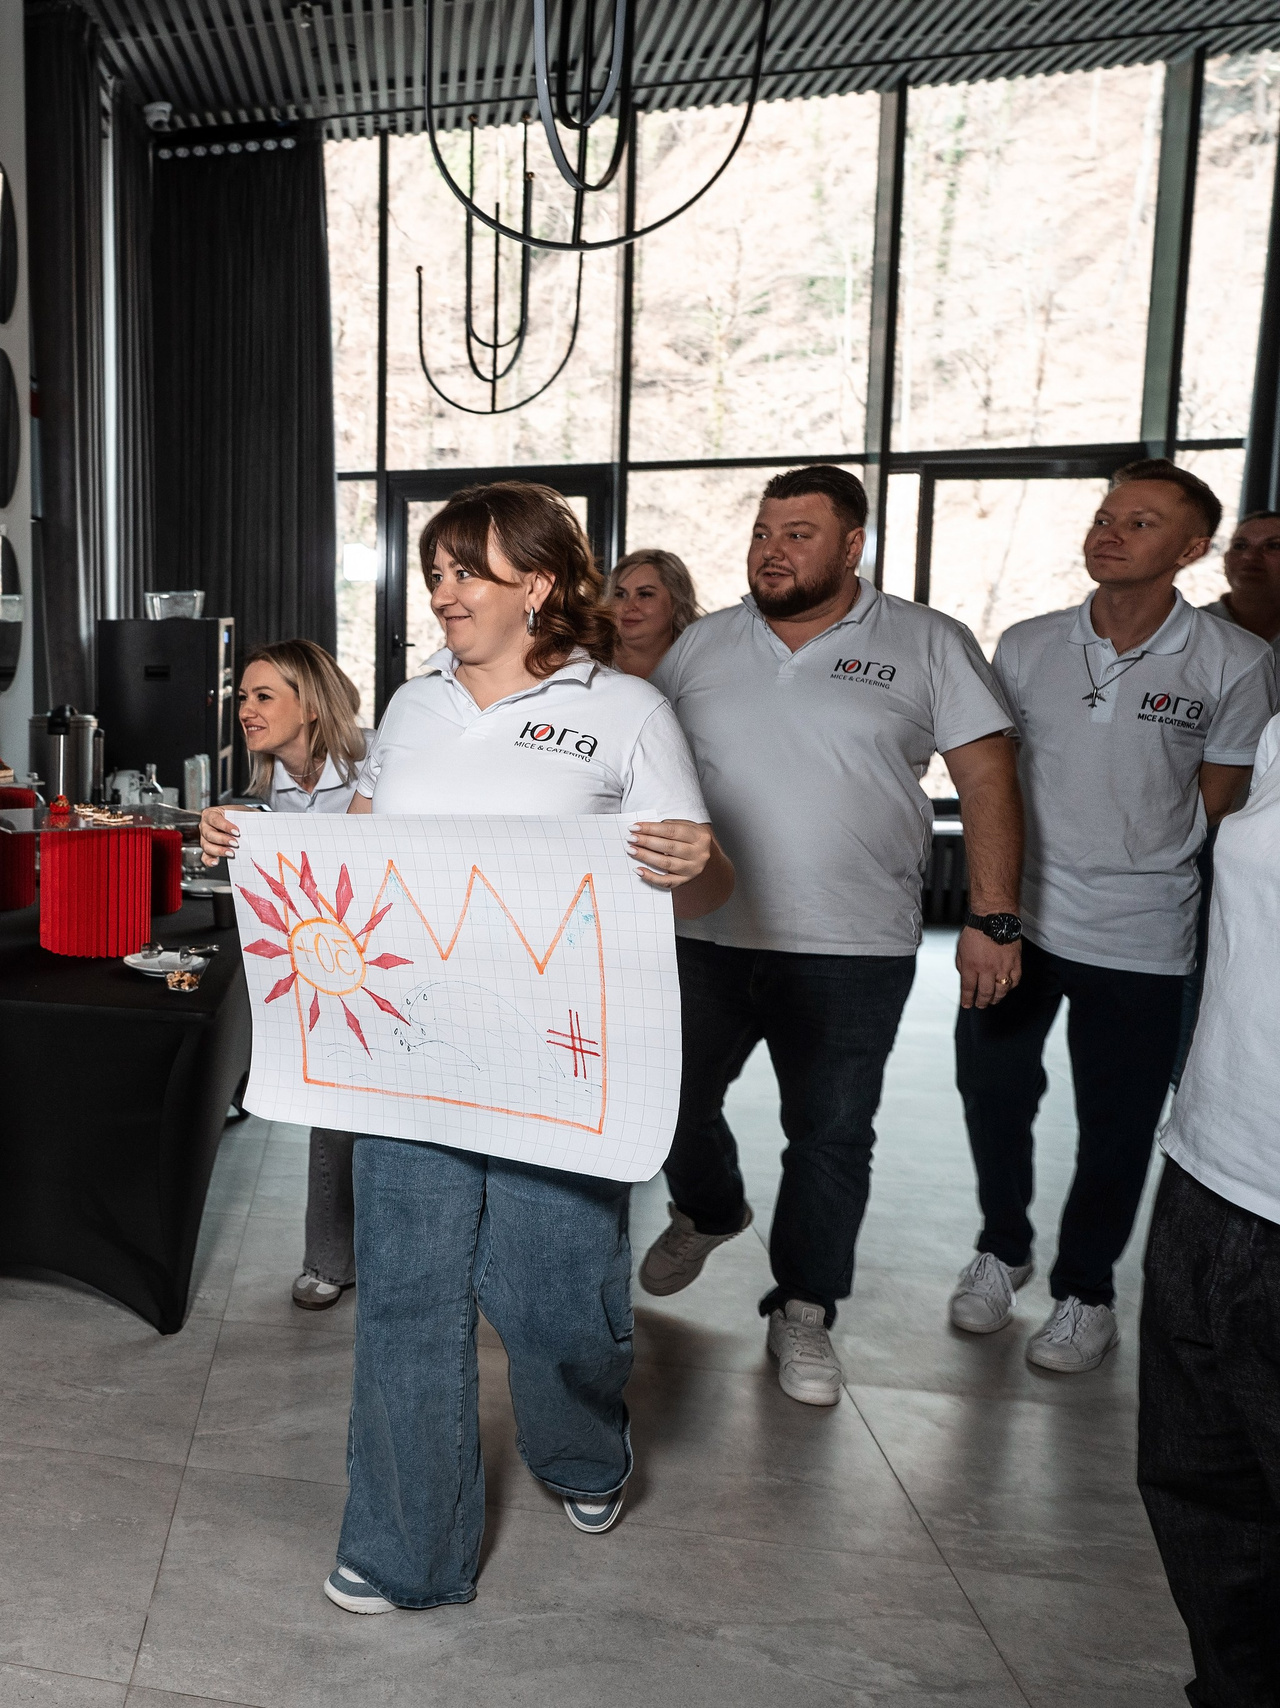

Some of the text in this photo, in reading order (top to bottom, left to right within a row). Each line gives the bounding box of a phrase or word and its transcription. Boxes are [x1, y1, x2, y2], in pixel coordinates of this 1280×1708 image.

[830, 673, 847, 681] MICE
[855, 676, 891, 690] CATERING
[1137, 713, 1157, 723] MICE
[1164, 717, 1196, 730] CATERING
[514, 740, 537, 750] MICE
[546, 746, 592, 763] CATERING
